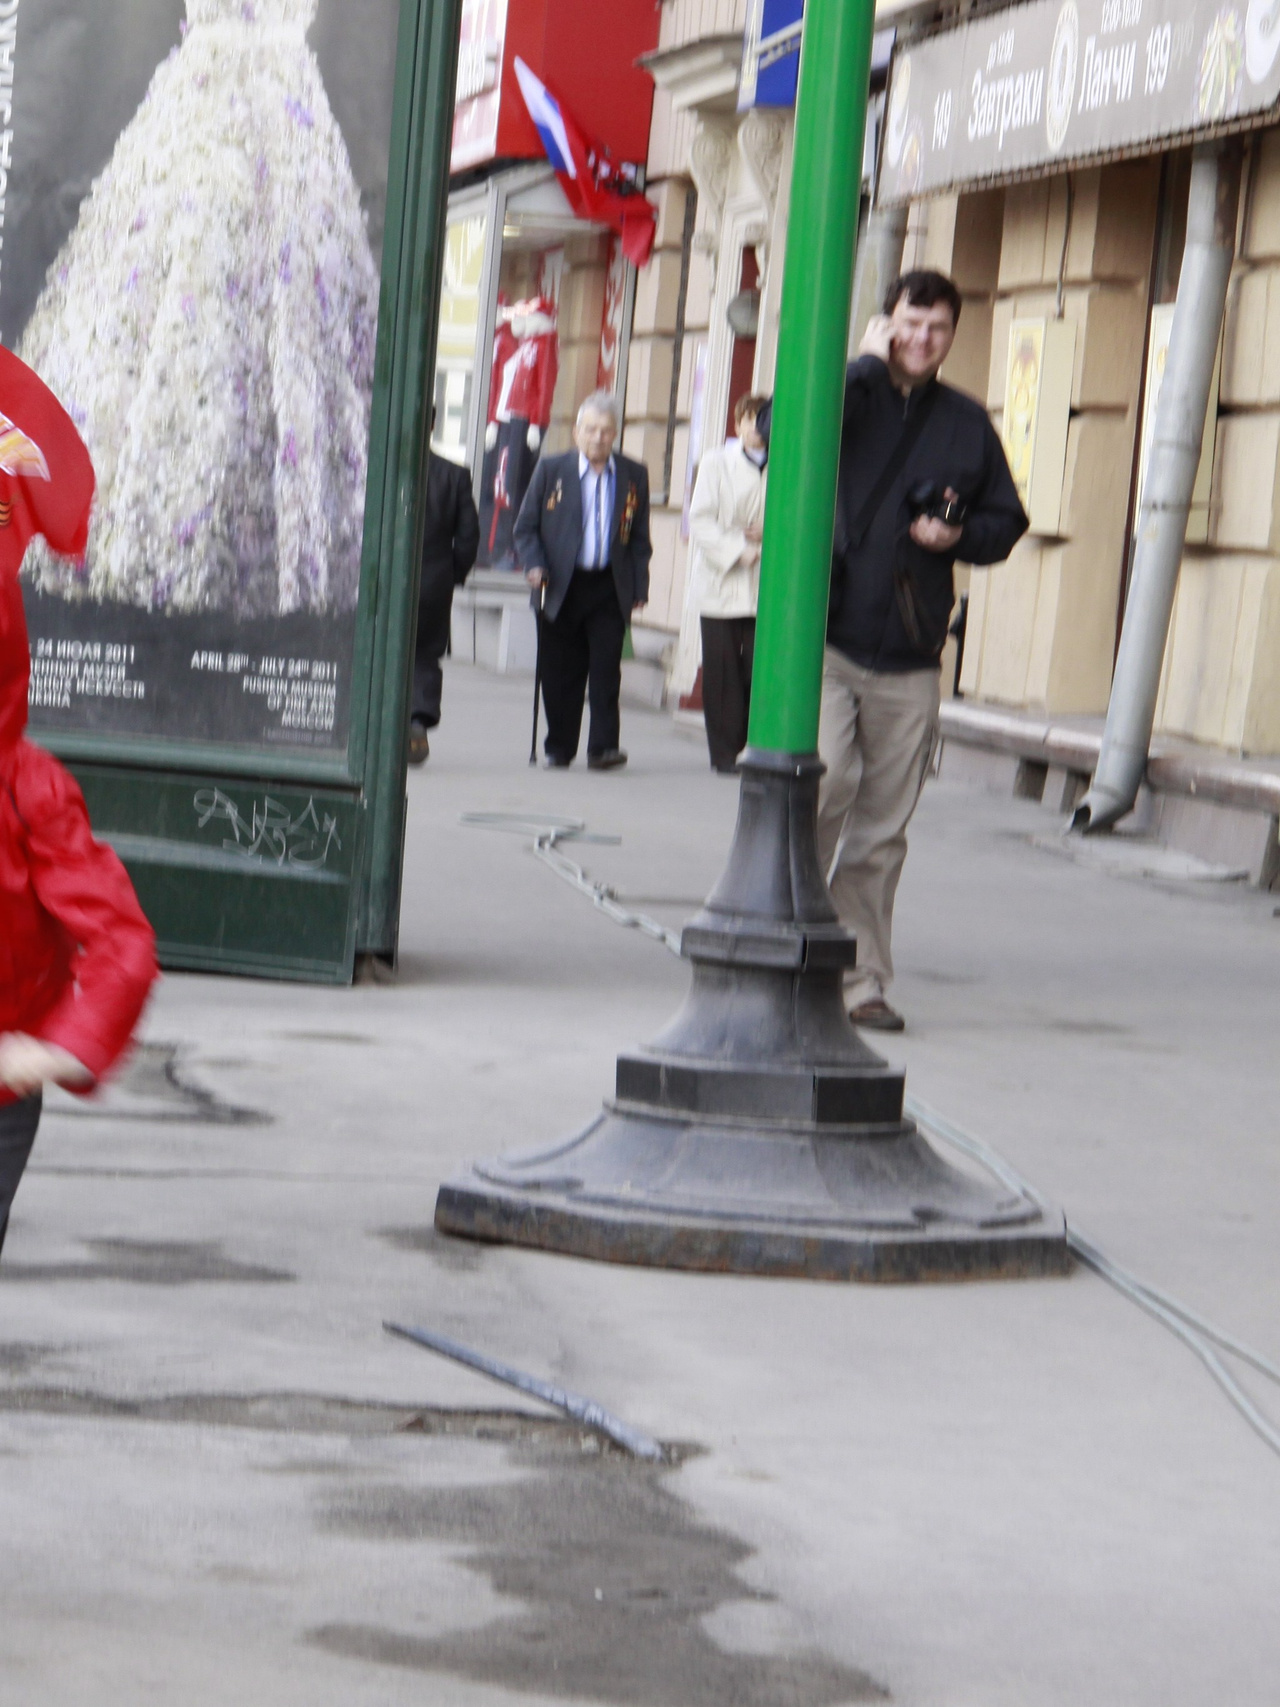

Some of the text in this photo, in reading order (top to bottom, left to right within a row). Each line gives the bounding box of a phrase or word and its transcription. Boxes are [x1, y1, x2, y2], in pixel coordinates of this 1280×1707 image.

[1078, 35, 1137, 115] Ланчи
[1144, 21, 1171, 96] 199
[968, 67, 1045, 151] Завтраки
[56, 639, 102, 662] ИЮЛЯ
[104, 642, 135, 665] 2011
[30, 658, 126, 681] ЕННЫЙ МУЗЕЙ
[191, 650, 223, 672] APRIL
[259, 655, 286, 677] JULY
[312, 659, 338, 682] 2011
[76, 677, 145, 699] ИСКУССТВ
[242, 674, 336, 700] PUSHKIN MUSEUM
[267, 693, 335, 715] OF FINE ARTS
[281, 709, 335, 731] MOSCOW
